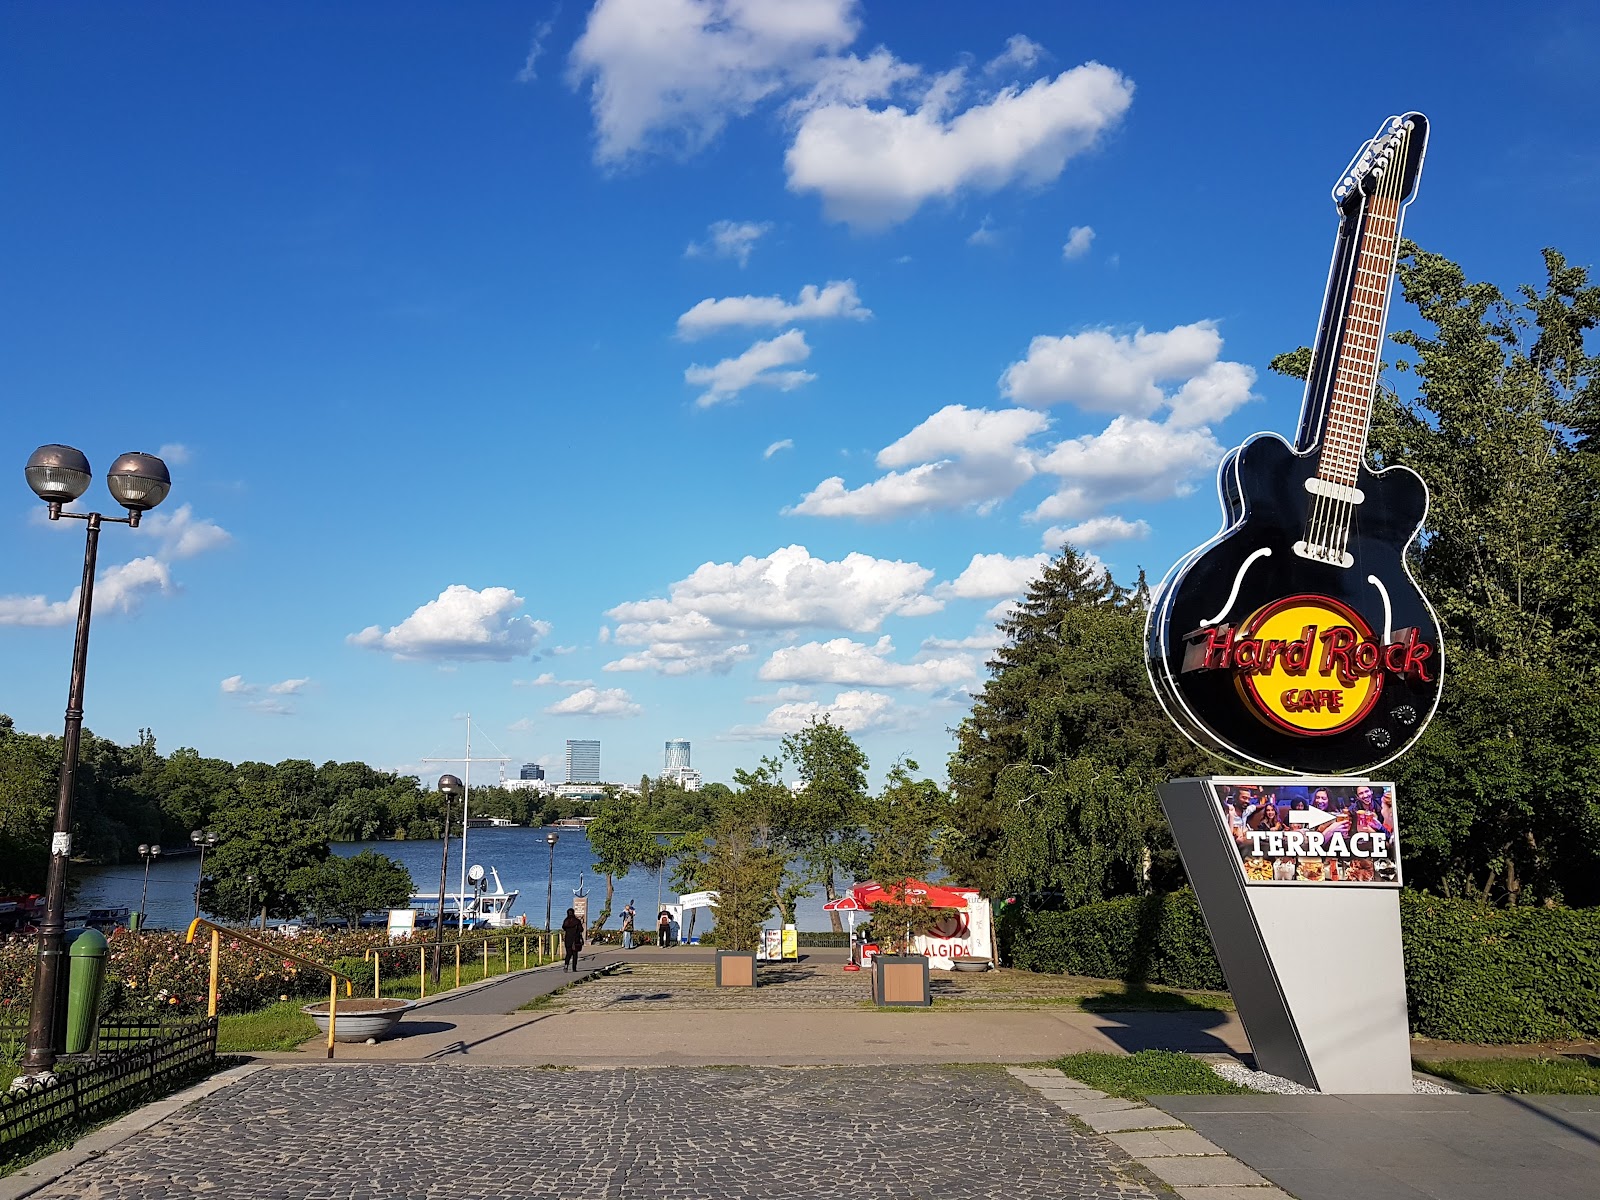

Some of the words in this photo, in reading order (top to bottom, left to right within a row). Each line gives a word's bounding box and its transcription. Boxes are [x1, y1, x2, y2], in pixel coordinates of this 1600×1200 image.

[1199, 623, 1317, 676] Hard
[1320, 625, 1434, 685] Rock
[1283, 688, 1344, 712] CAFE
[1246, 830, 1388, 858] TERRACE
[923, 944, 971, 957] ALGIDA
